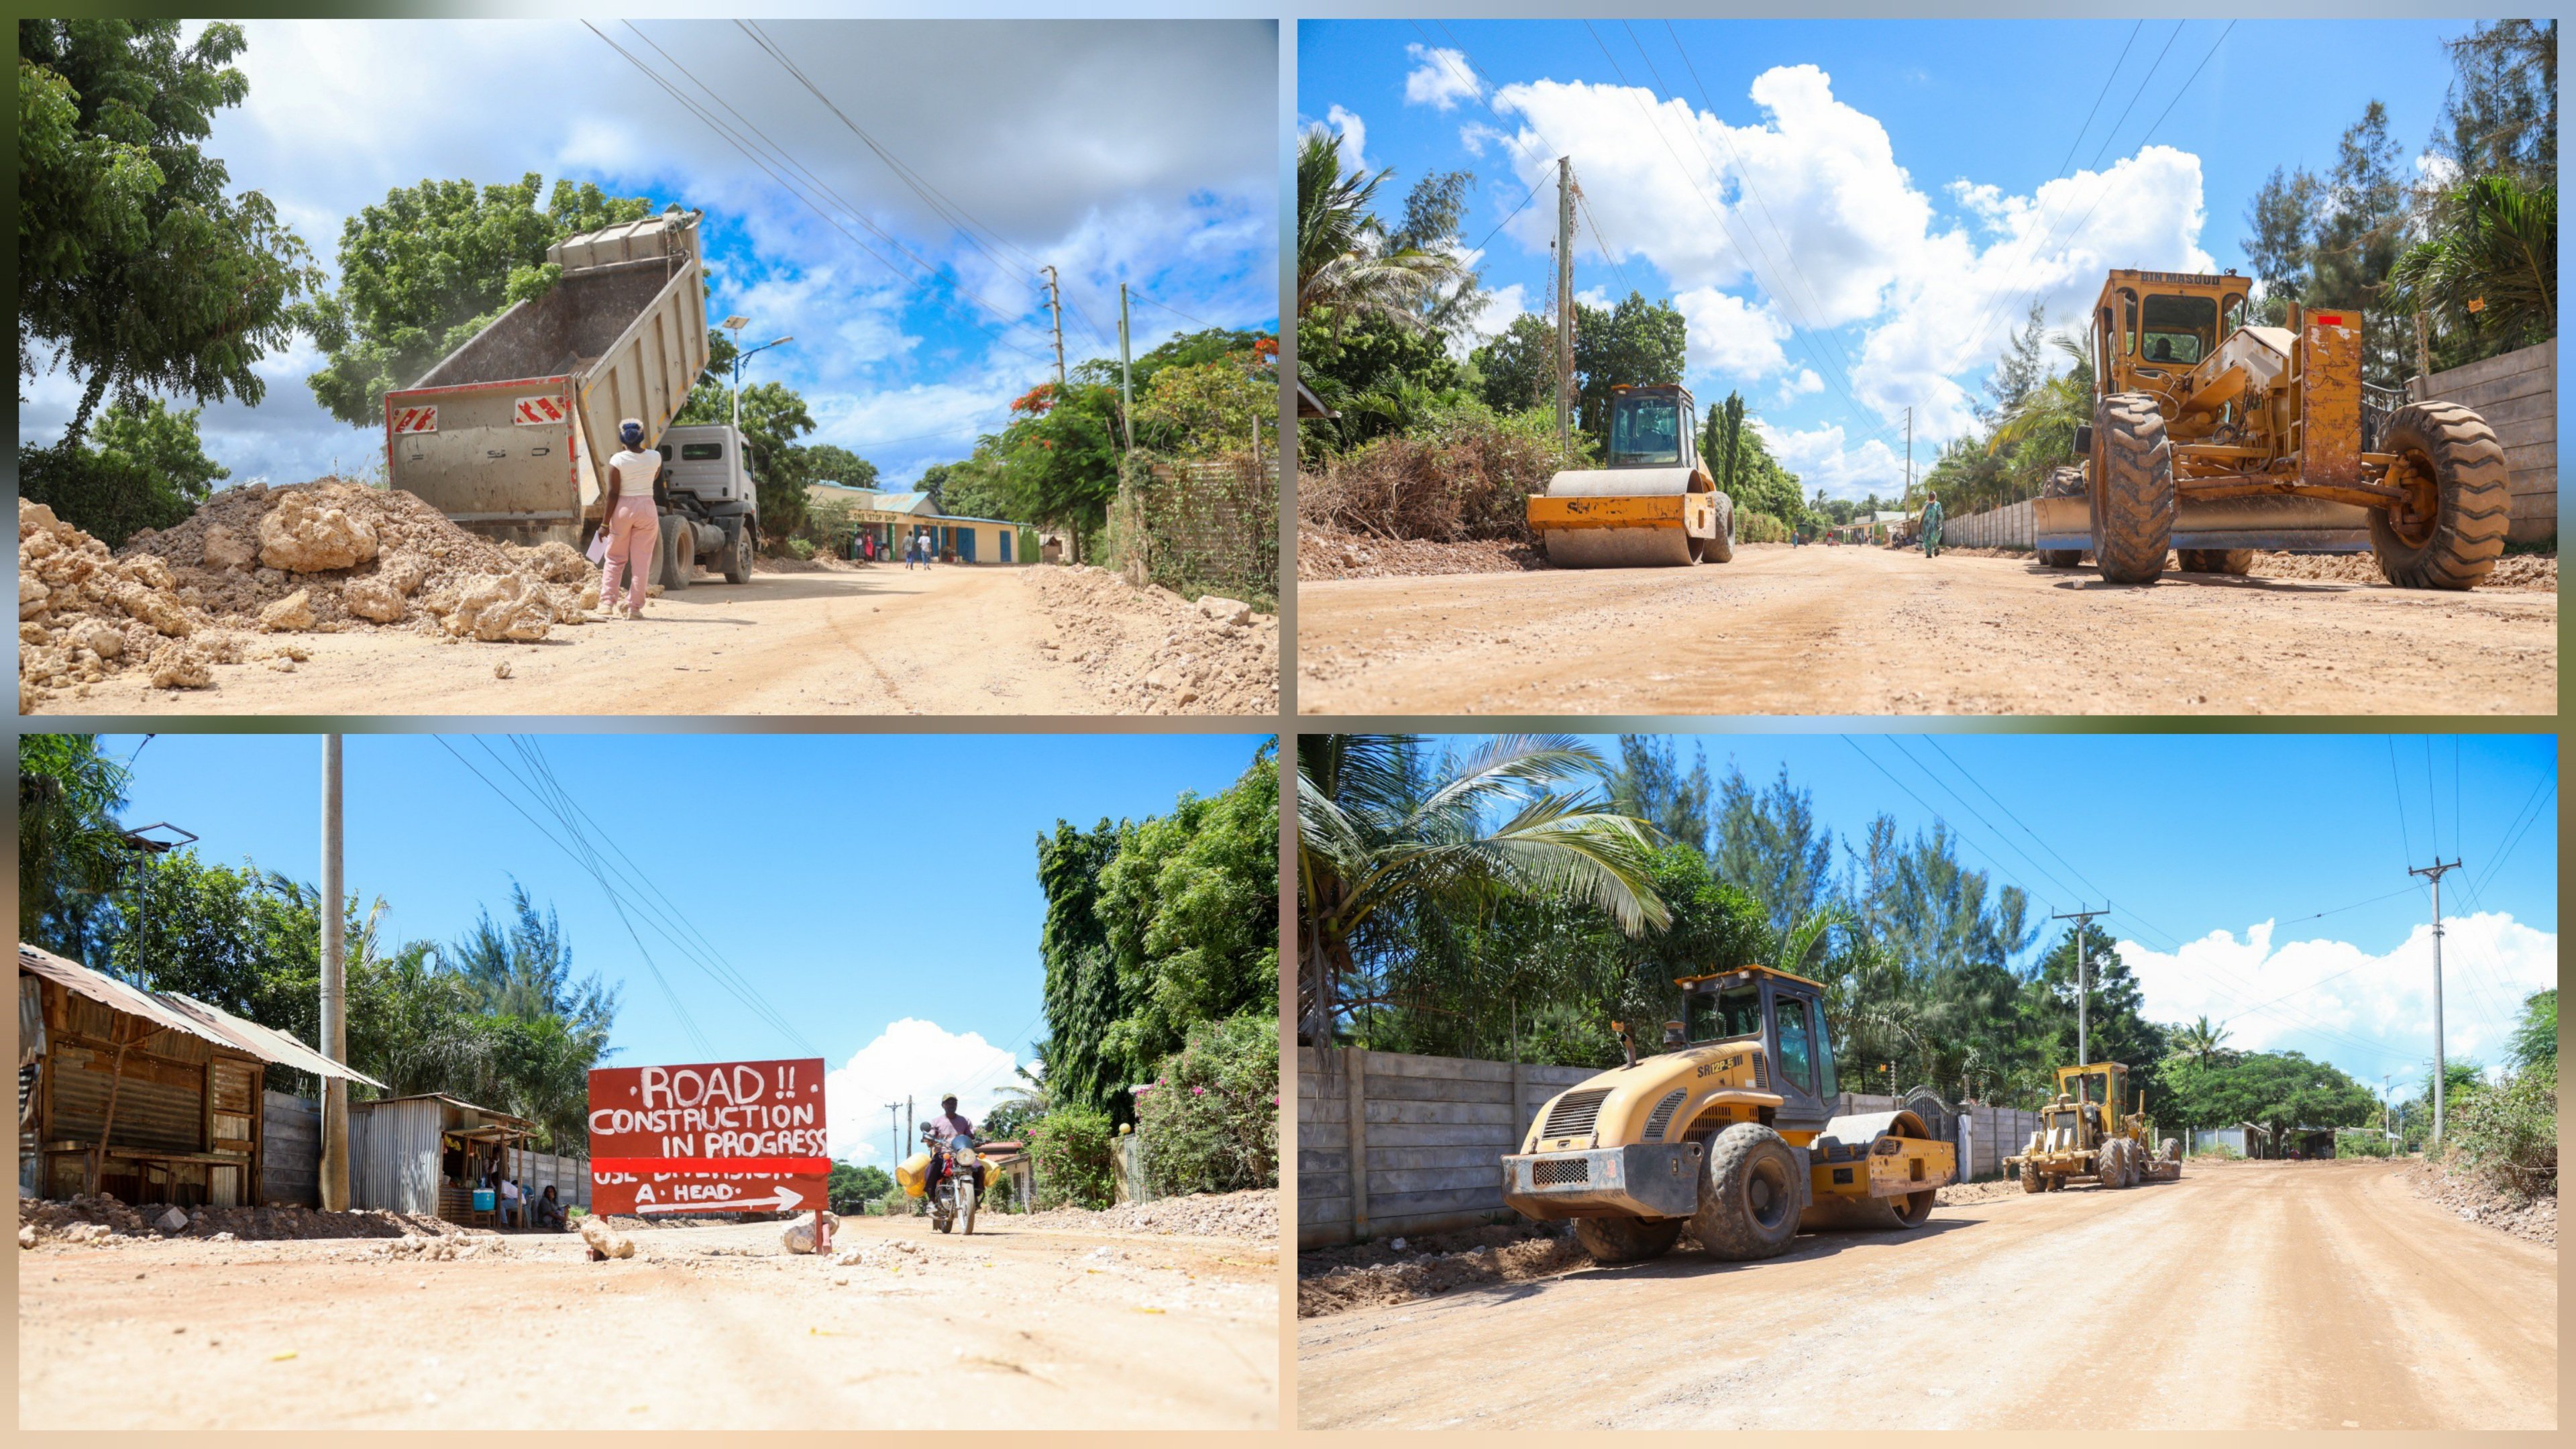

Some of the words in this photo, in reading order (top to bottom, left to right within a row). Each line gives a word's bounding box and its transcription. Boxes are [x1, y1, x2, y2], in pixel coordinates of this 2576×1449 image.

[2141, 271, 2162, 282] BIN
[2166, 272, 2220, 285] MASOUD
[853, 513, 865, 521] ONE
[868, 513, 882, 521] STOP
[641, 1065, 765, 1109] ROAD
[588, 1103, 814, 1135] CONSTRUCTION
[662, 1133, 694, 1159] IN
[704, 1128, 827, 1159] PROGRESS
